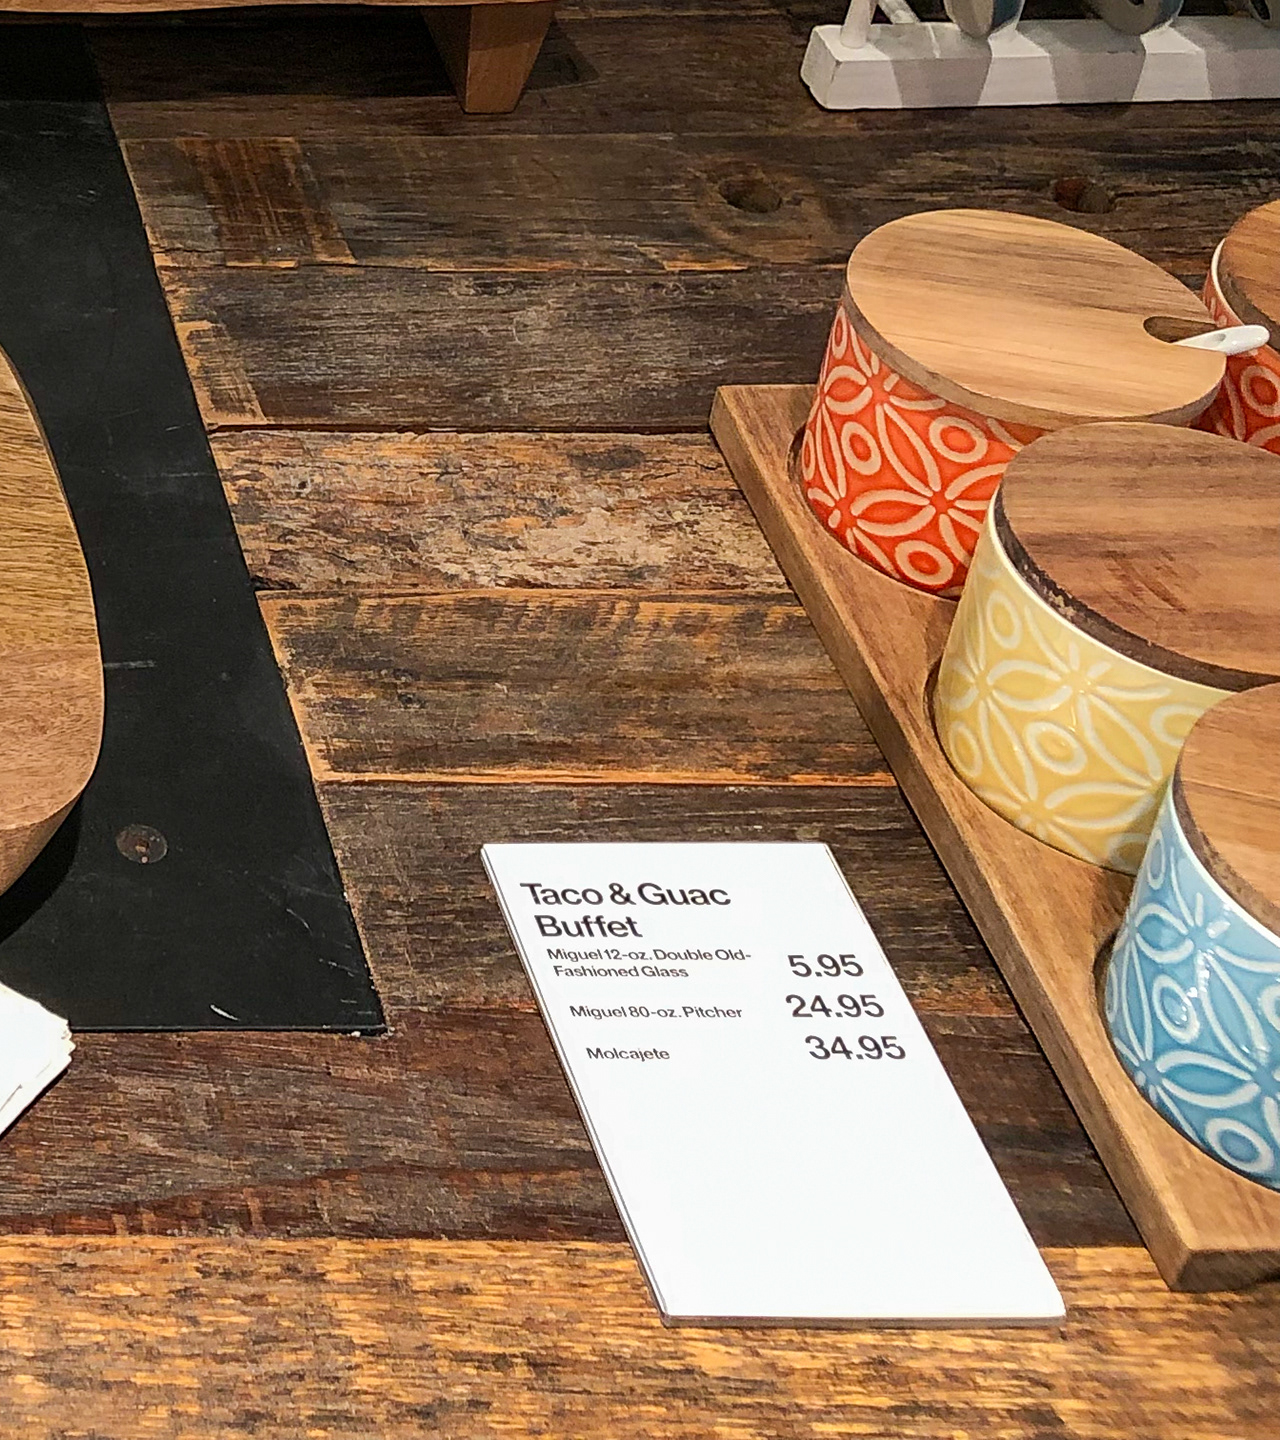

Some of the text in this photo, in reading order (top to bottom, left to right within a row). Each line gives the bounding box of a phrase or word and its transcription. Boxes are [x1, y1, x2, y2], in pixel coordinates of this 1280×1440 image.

[520, 882, 731, 906] Taco & Guac
[534, 914, 643, 938] Buffet
[547, 948, 751, 963] Miguel 12-oz. Double Old-
[553, 953, 864, 978] Fashioned Glass 5.95
[569, 994, 885, 1020] Miguel 80-oz. Pitcher 24.95
[586, 1035, 907, 1062] Molcajete 34.95
